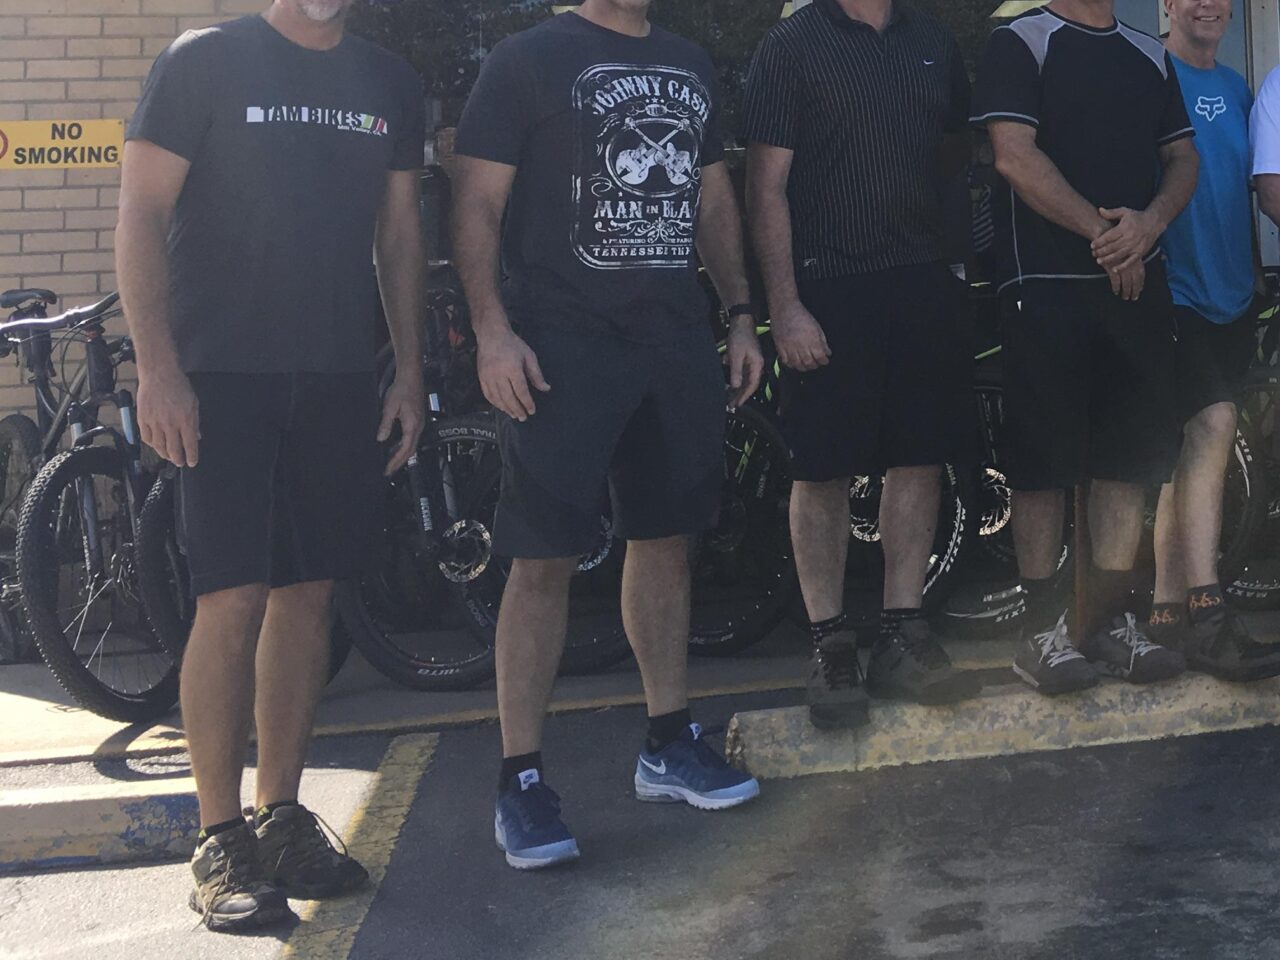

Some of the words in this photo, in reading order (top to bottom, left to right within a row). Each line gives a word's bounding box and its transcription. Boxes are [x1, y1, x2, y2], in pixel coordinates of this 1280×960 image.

[593, 75, 663, 115] JOHNNY
[667, 79, 709, 123] CASH
[51, 122, 82, 140] NO
[14, 146, 118, 165] SMOKING
[593, 200, 643, 219] MAN
[646, 205, 659, 214] IN
[662, 200, 693, 219] BLA
